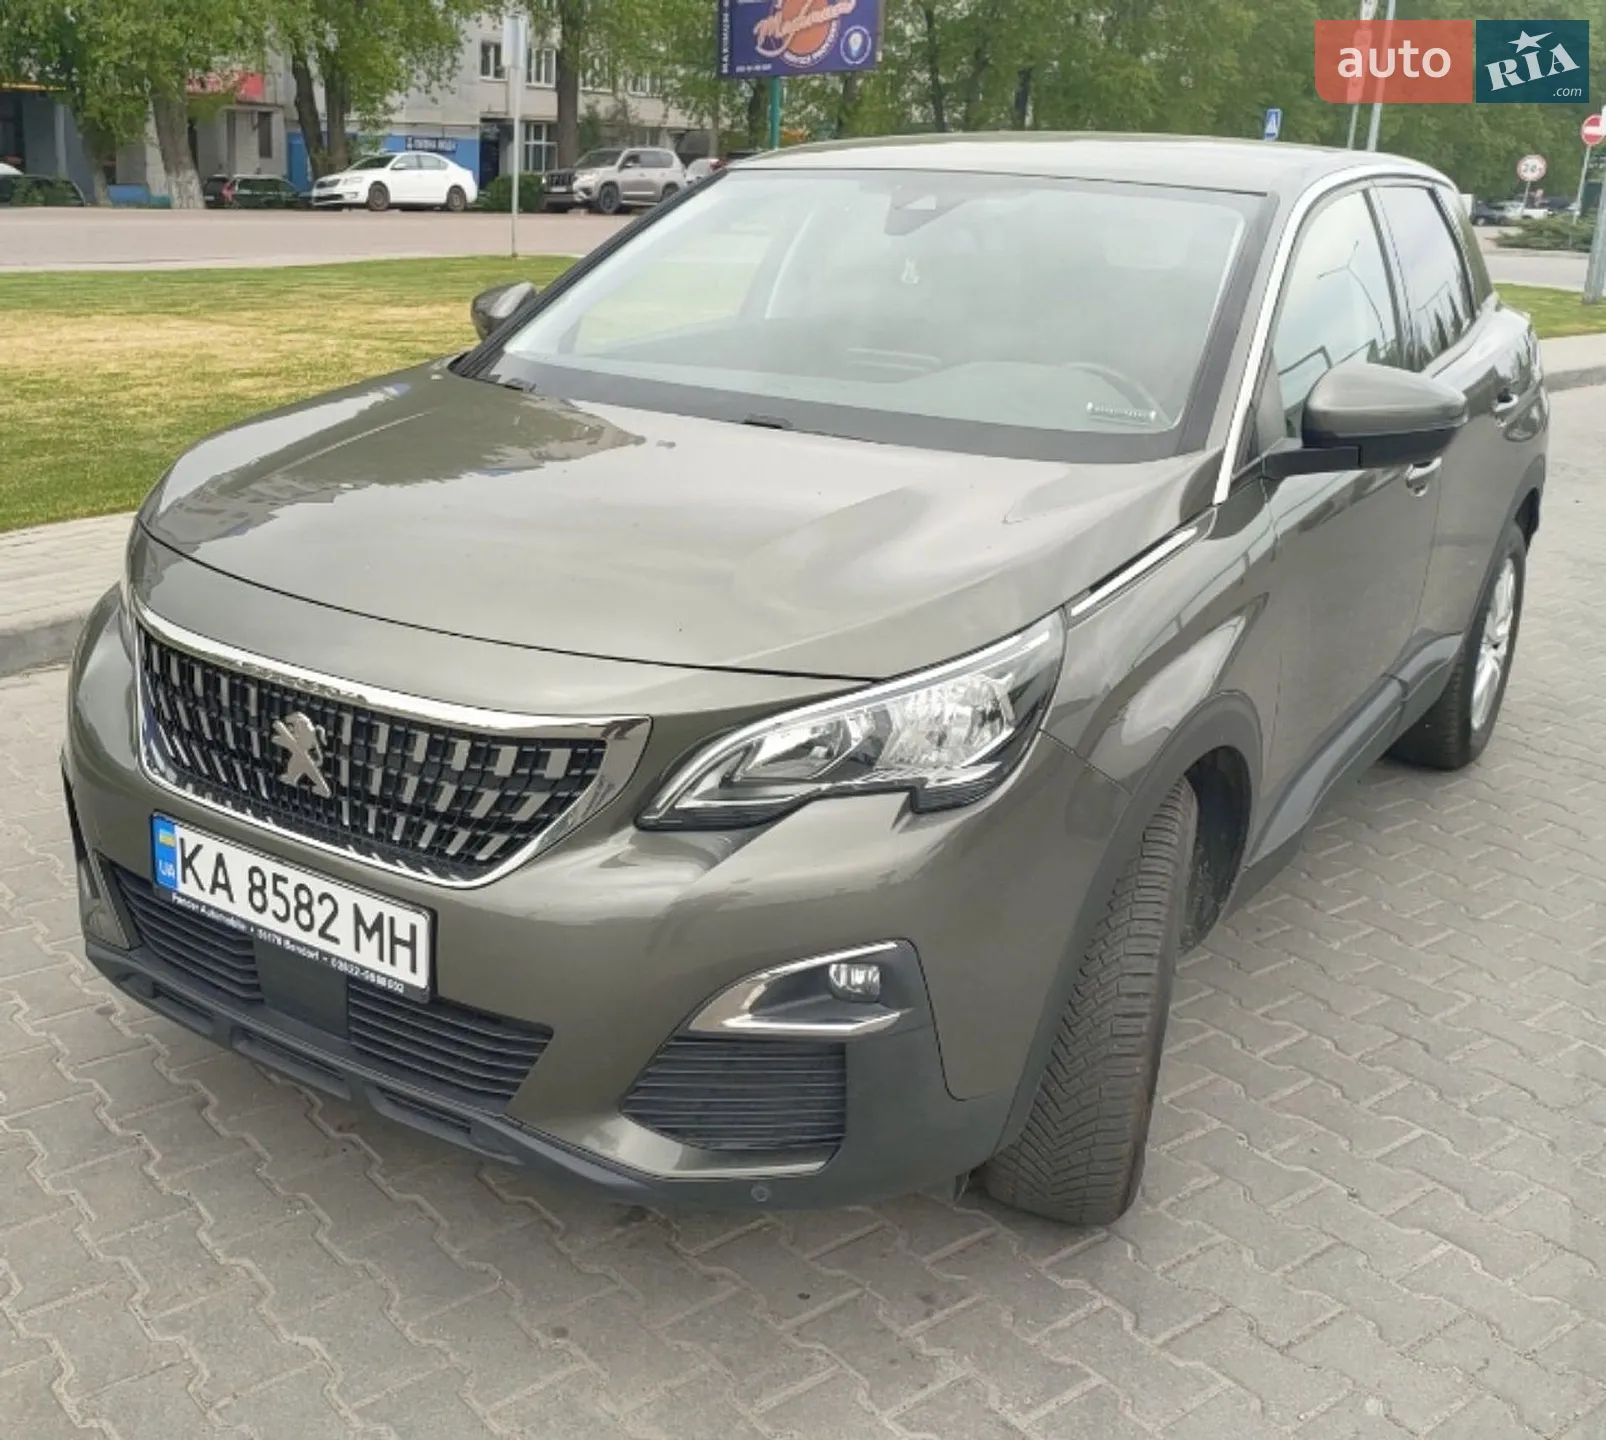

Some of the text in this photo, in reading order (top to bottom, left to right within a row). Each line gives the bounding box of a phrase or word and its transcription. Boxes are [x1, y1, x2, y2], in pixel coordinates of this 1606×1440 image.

[158, 858, 176, 879] UA
[179, 836, 417, 974] KA 8582 MH
